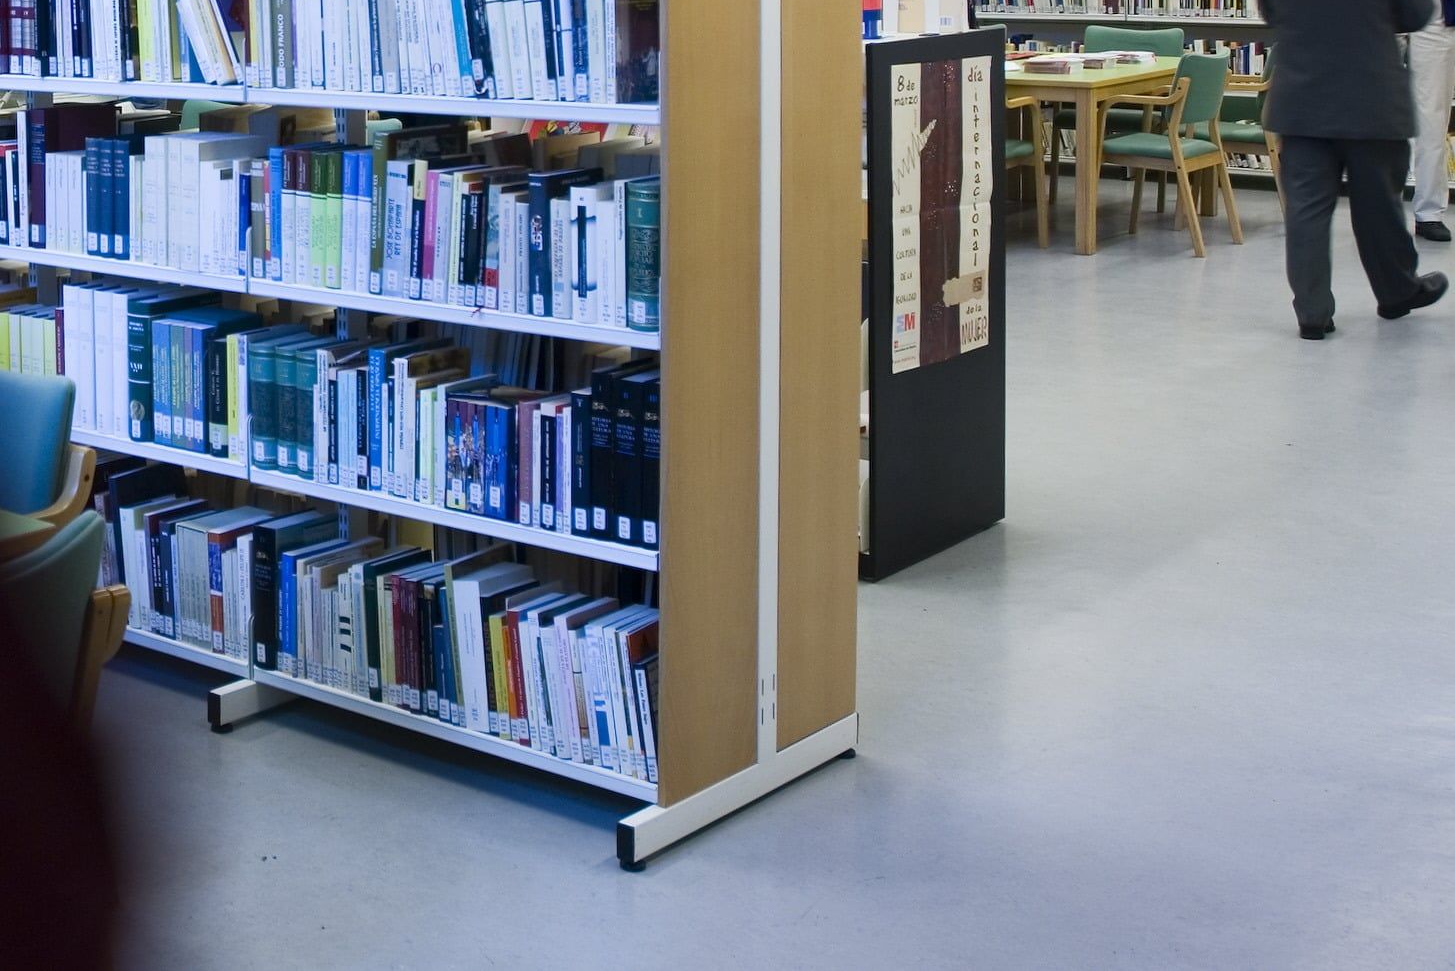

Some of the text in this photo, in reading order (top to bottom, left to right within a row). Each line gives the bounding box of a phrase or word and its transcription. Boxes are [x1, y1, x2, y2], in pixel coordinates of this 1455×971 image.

[968, 65, 983, 82] día
[897, 75, 915, 92] 8 de
[894, 95, 919, 106] marzo
[961, 316, 988, 346] MUJER
